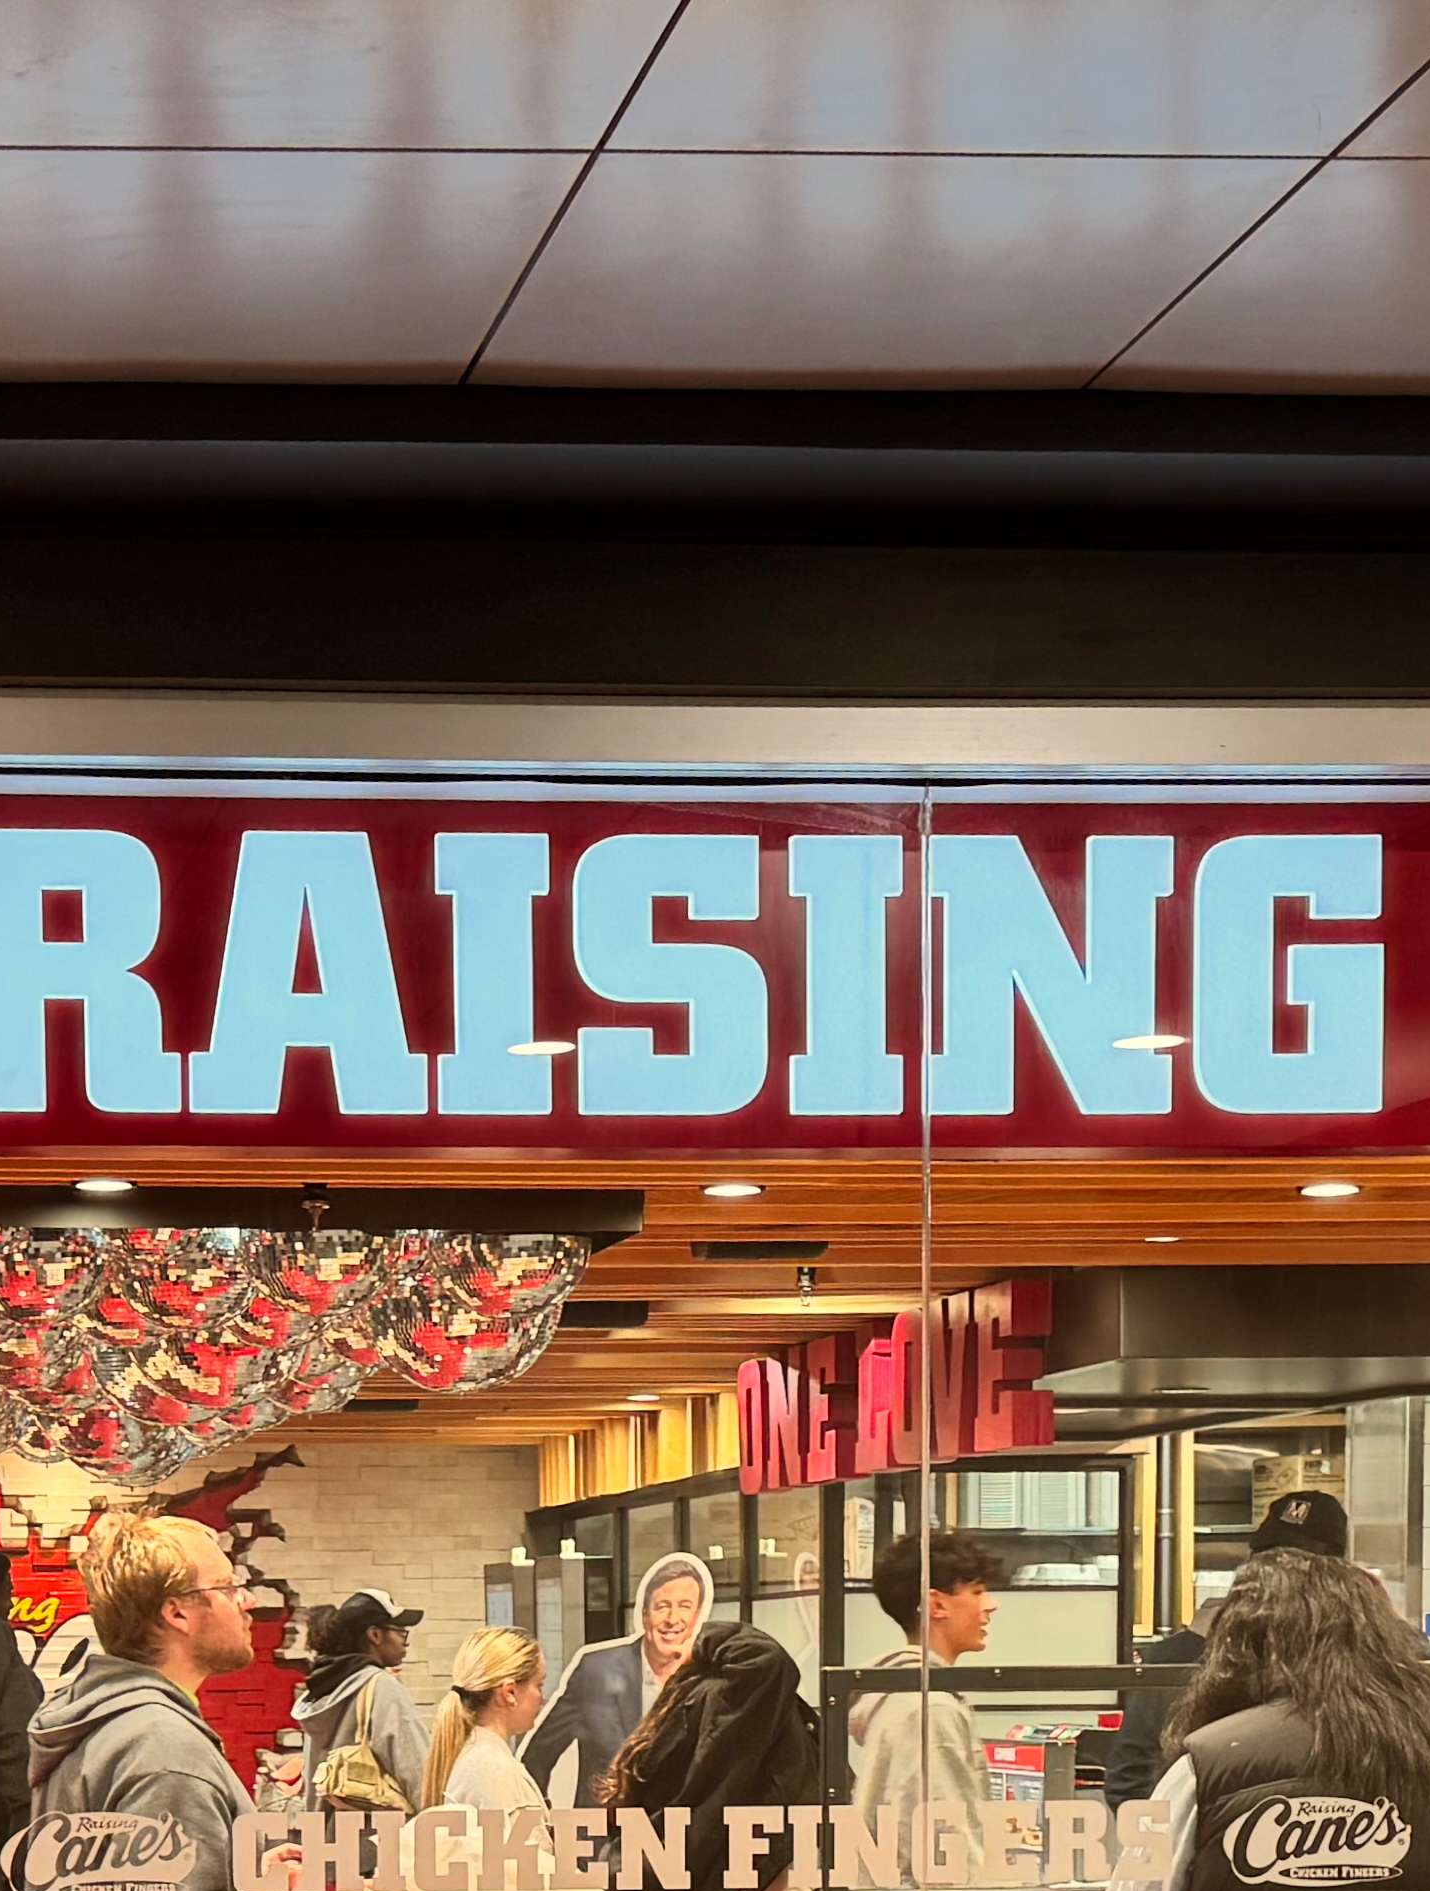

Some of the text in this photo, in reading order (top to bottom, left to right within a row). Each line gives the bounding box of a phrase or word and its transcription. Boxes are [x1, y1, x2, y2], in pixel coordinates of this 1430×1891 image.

[737, 1280, 1032, 1495] ONE LOVE
[75, 1816, 139, 1833] Raising
[722, 1799, 1172, 1890] FINGERS
[1233, 1797, 1407, 1879] Cane's
[1296, 1801, 1357, 1818] Raising
